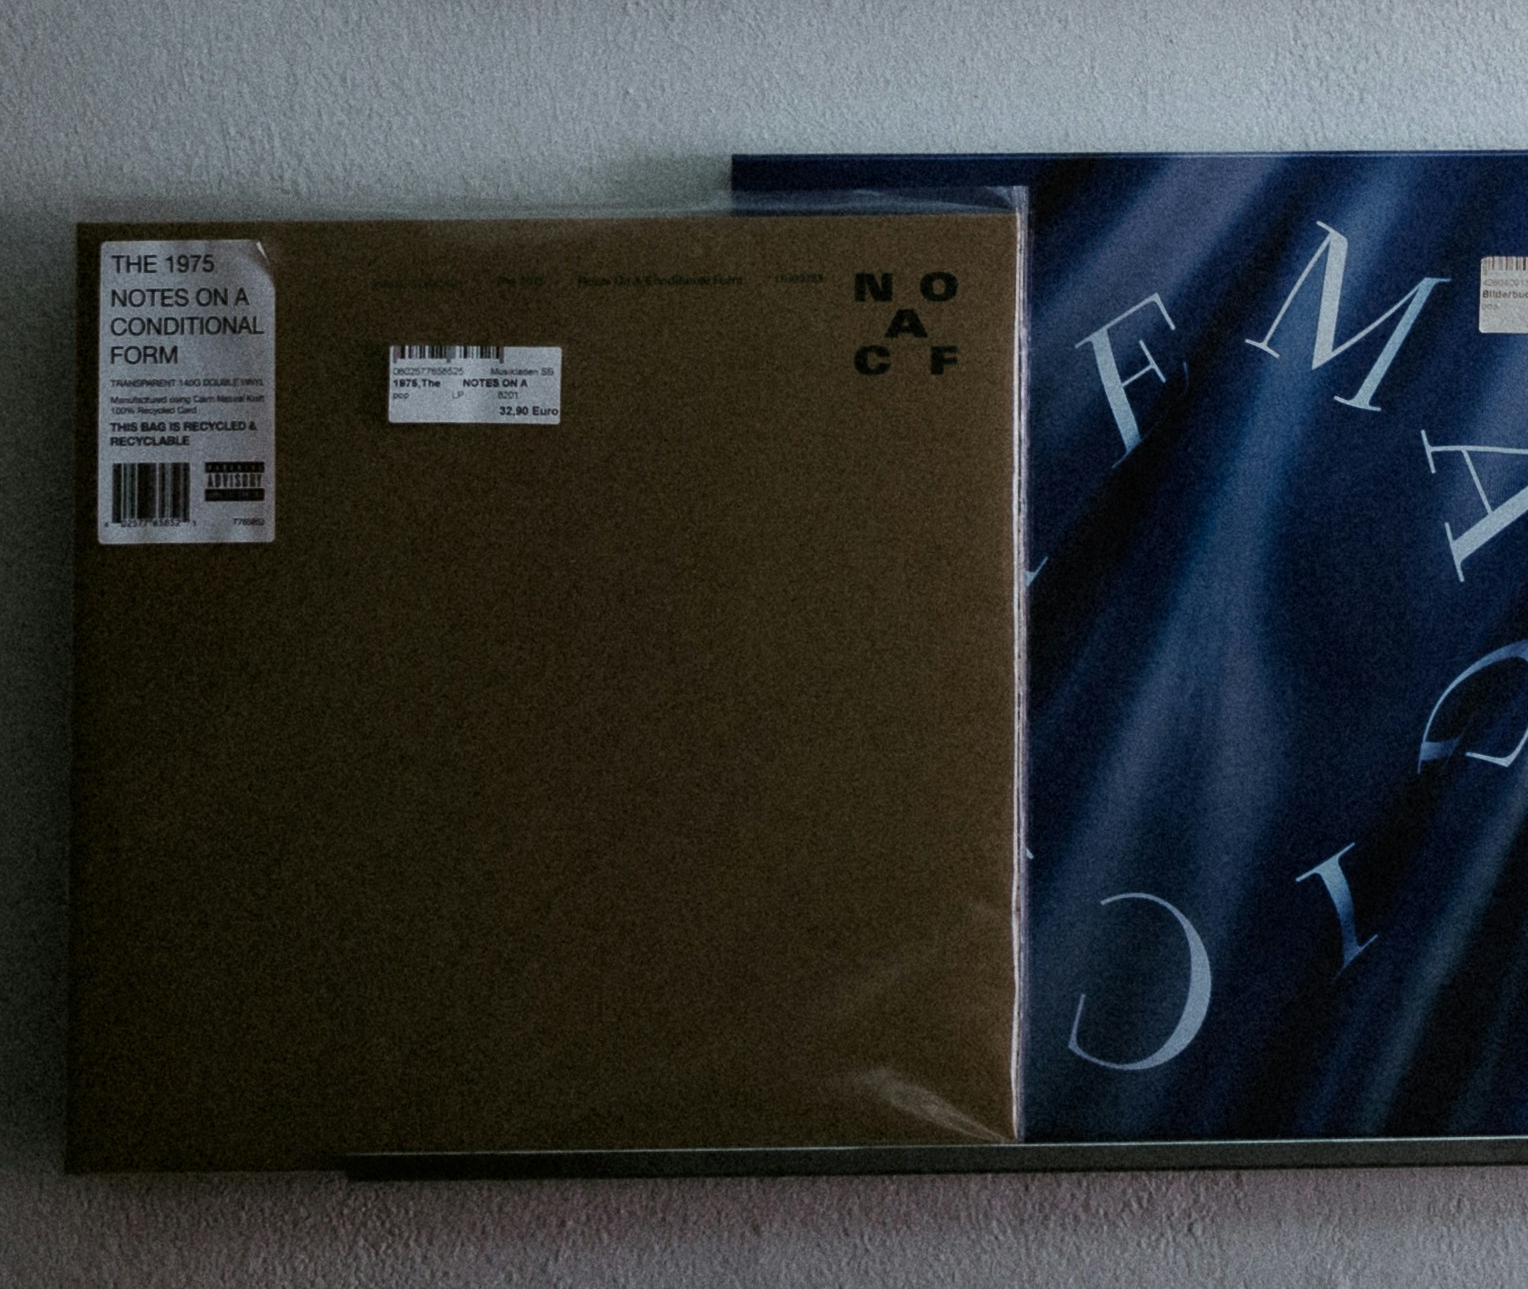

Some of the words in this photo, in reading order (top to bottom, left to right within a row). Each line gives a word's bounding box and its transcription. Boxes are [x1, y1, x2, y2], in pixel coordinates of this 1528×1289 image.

[111, 255, 157, 273] THE
[165, 254, 215, 273] 1975
[853, 272, 894, 303] N
[919, 271, 960, 303] O
[111, 288, 189, 307] NOTES
[196, 287, 228, 307] ON
[234, 287, 249, 306] A
[111, 316, 265, 336] CONDITIONAL
[884, 308, 929, 339] A
[110, 346, 178, 364] FORM
[852, 345, 891, 377] C
[929, 345, 959, 376] F
[393, 379, 441, 389] 1975,The
[463, 378, 500, 388] NOTES
[502, 378, 518, 387] ON
[520, 379, 528, 387] A
[499, 406, 528, 417] 32,90
[532, 406, 558, 416] Euro
[110, 422, 138, 432] THIS
[141, 422, 166, 432] BAG
[169, 421, 180, 431] IS
[183, 421, 246, 431] RECYCLED
[248, 420, 257, 431] &
[110, 436, 190, 447] RECYCLABLE
[207, 474, 262, 488] ADVISORY
